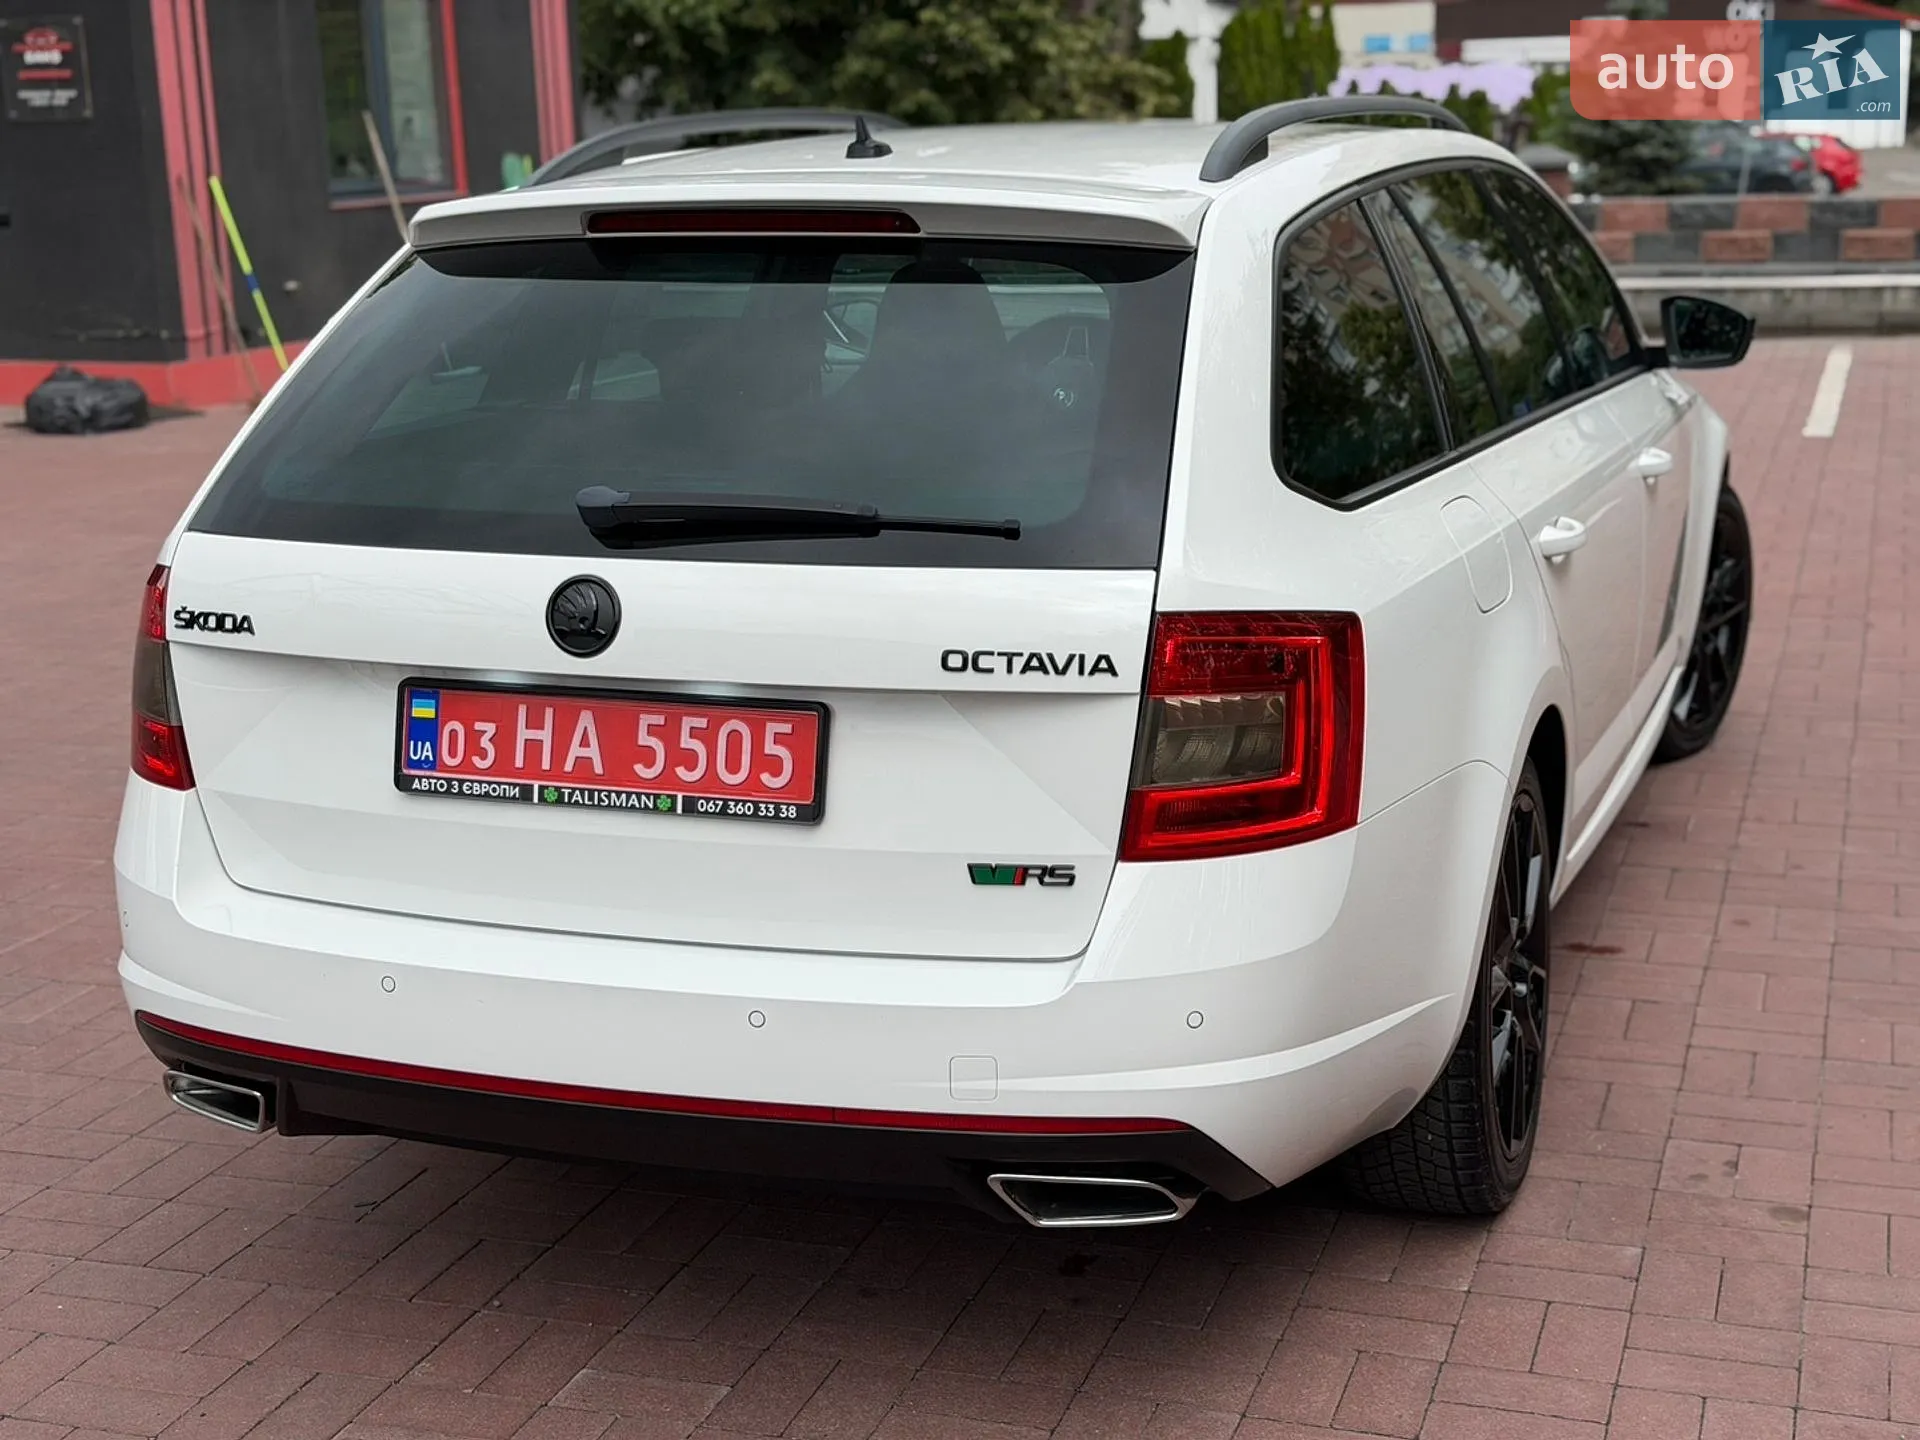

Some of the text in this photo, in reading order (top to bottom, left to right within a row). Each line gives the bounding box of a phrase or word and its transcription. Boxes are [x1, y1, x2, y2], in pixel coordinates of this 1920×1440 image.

[174, 605, 255, 636] ŠKODA
[941, 649, 1119, 677] OCTAVIA
[410, 740, 434, 761] UA
[441, 704, 795, 790] 03 HA 5505
[412, 778, 447, 792] АВТО
[463, 782, 520, 799] ЄВРОПИ
[561, 788, 654, 810] TALISMAN
[697, 799, 797, 818] 067 360 33 38
